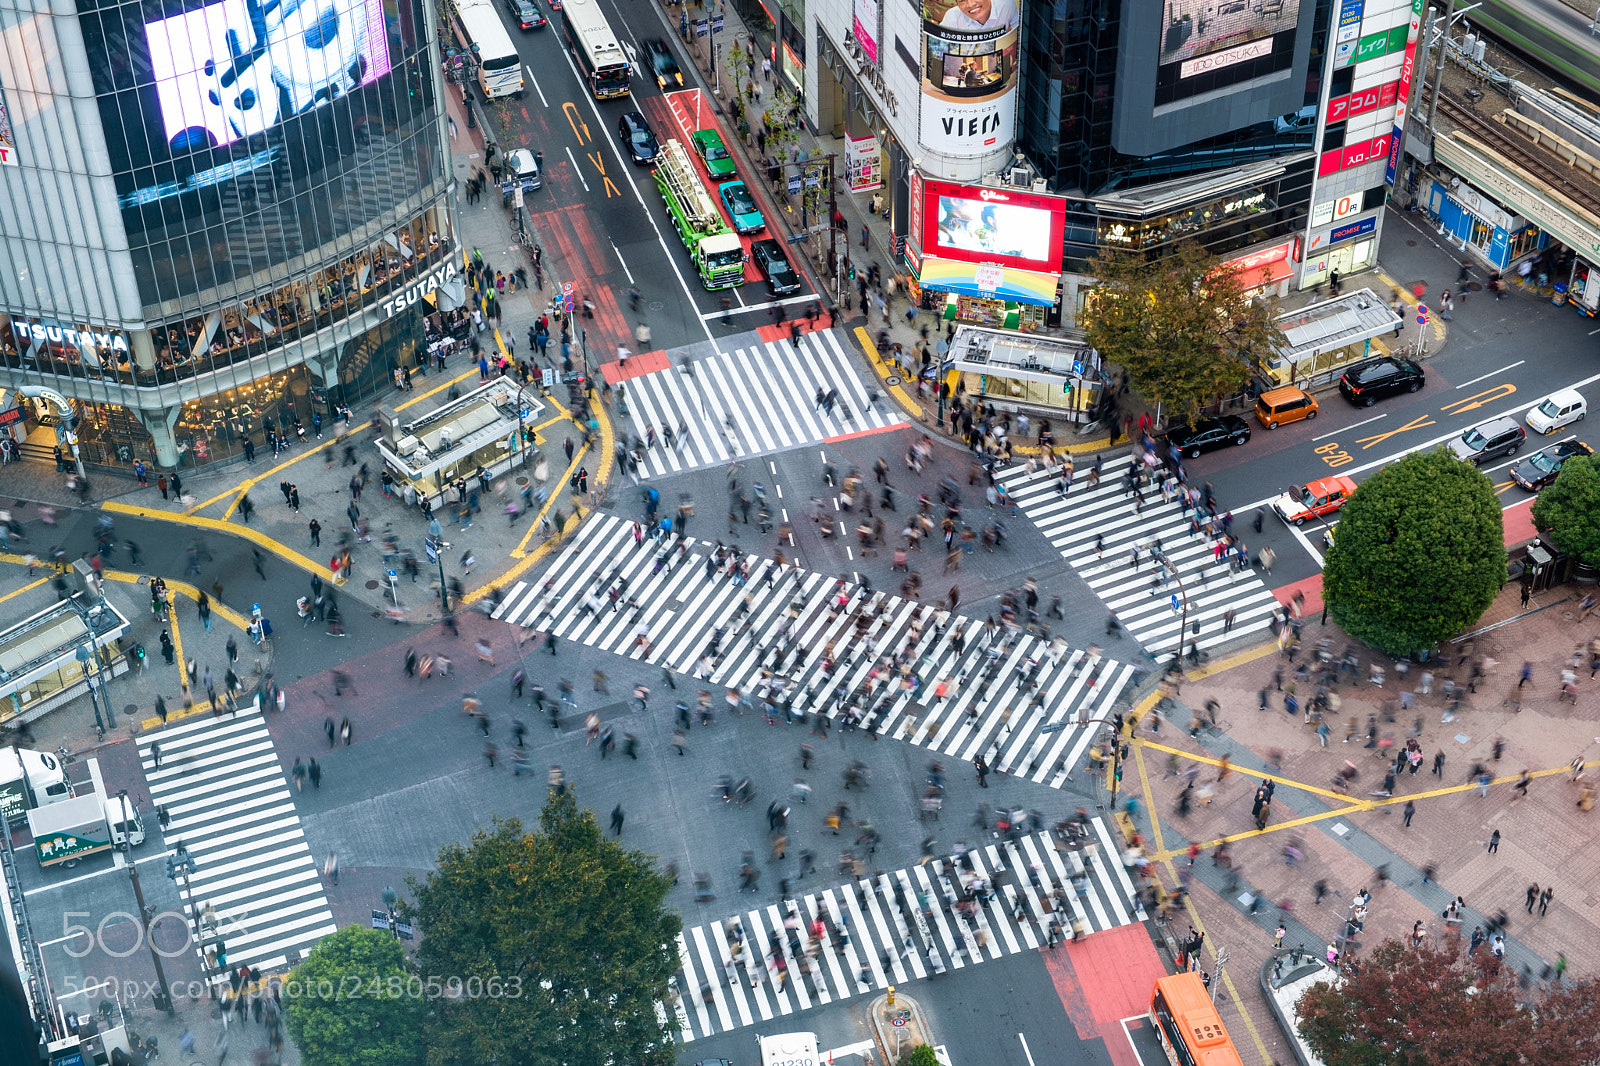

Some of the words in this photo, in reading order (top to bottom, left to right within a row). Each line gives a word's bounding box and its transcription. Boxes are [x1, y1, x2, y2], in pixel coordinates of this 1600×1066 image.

[1215, 45, 1260, 66] OTSUKA
[1358, 37, 1387, 55] レイク
[1333, 93, 1377, 117] アコム
[941, 112, 1001, 136] VIERA
[1347, 153, 1364, 165] 入口
[1106, 234, 1132, 243] COFFEE
[1333, 225, 1361, 239] PROMISE
[383, 262, 456, 318] TSUTAYA
[15, 321, 129, 351] TSUTAYA
[1314, 442, 1354, 468] 8-20
